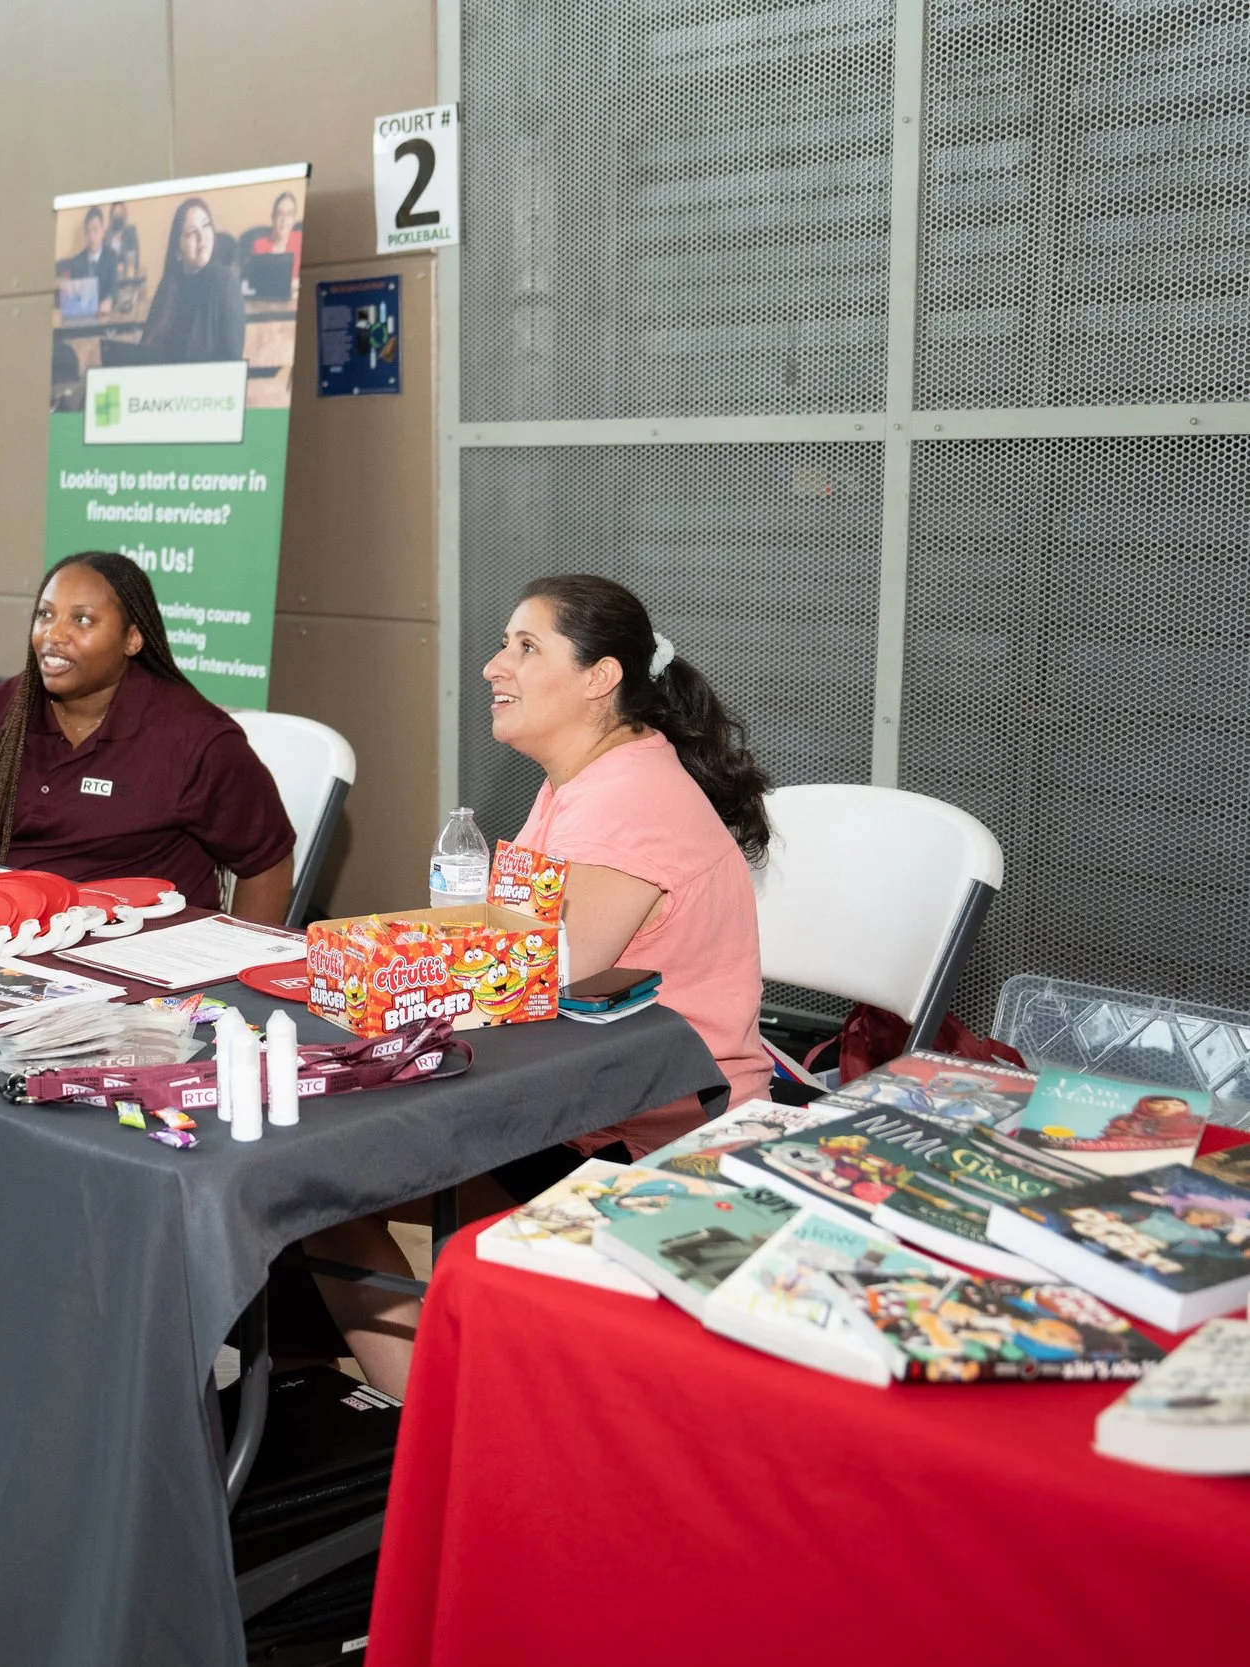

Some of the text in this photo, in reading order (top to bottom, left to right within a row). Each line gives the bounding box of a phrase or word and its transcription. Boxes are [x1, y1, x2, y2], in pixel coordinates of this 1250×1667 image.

[380, 109, 450, 138] COURT #
[394, 138, 440, 229] 2
[387, 228, 451, 246] PICKLEBALL
[60, 468, 268, 496] Looking to start a career in
[86, 500, 231, 525] financial services?
[161, 546, 195, 573] Us!
[207, 608, 251, 625] course
[199, 655, 266, 678] interviews
[83, 780, 110, 793] RTC
[497, 848, 531, 876] efrutti
[494, 883, 531, 900] BURGER
[310, 942, 344, 980] efrutti
[314, 977, 327, 990] MINI
[376, 958, 445, 992] efrutti
[310, 987, 346, 1010] BURGER
[395, 990, 425, 1009] MINI
[384, 992, 471, 1031] BURGER
[375, 1041, 400, 1055] RTC
[911, 1051, 1039, 1082] STEVE SHEINK
[185, 1091, 215, 1104] RTC
[297, 1080, 322, 1093] RTC
